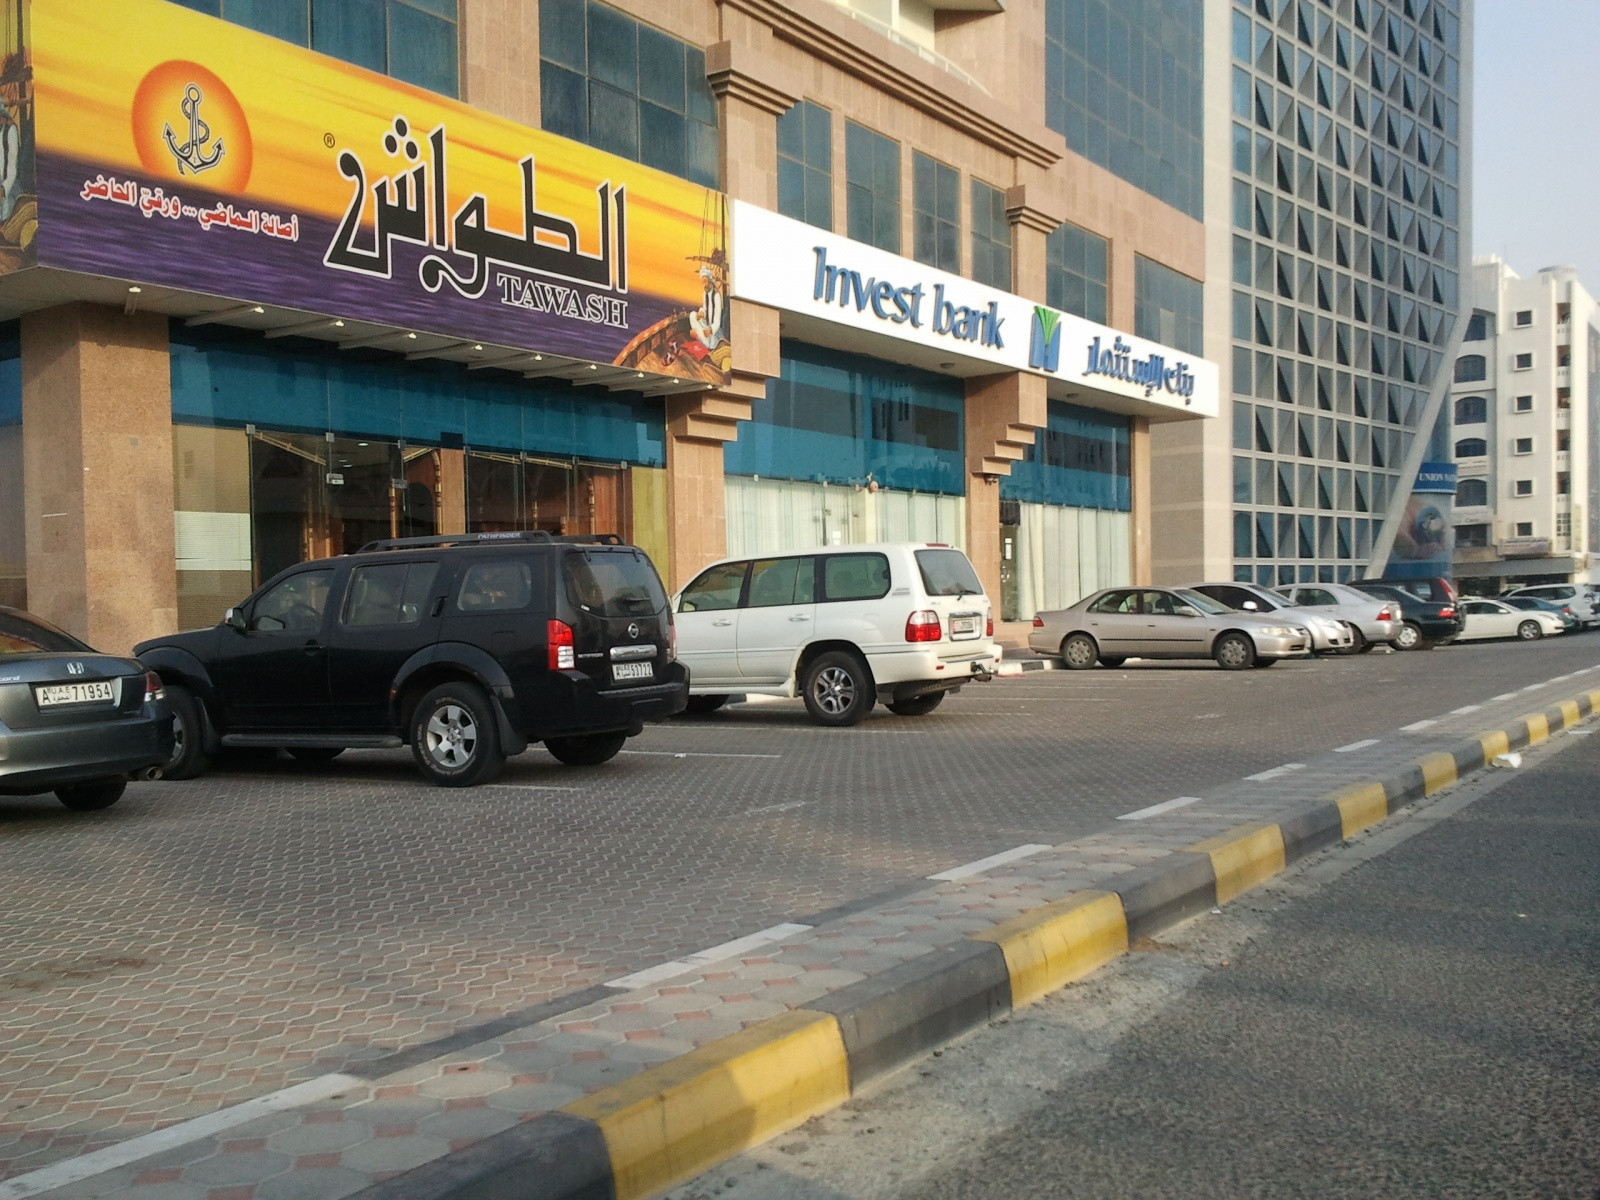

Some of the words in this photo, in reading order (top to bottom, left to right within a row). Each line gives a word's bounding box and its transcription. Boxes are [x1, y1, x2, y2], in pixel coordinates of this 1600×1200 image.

[80, 174, 137, 206] الحاضر
[323, 115, 628, 299] الطواش
[496, 272, 629, 329] TAWASH
[813, 246, 926, 329] Invest
[932, 283, 1006, 350] bank
[477, 532, 521, 540] PATHFINDER
[72, 683, 111, 701] 71954
